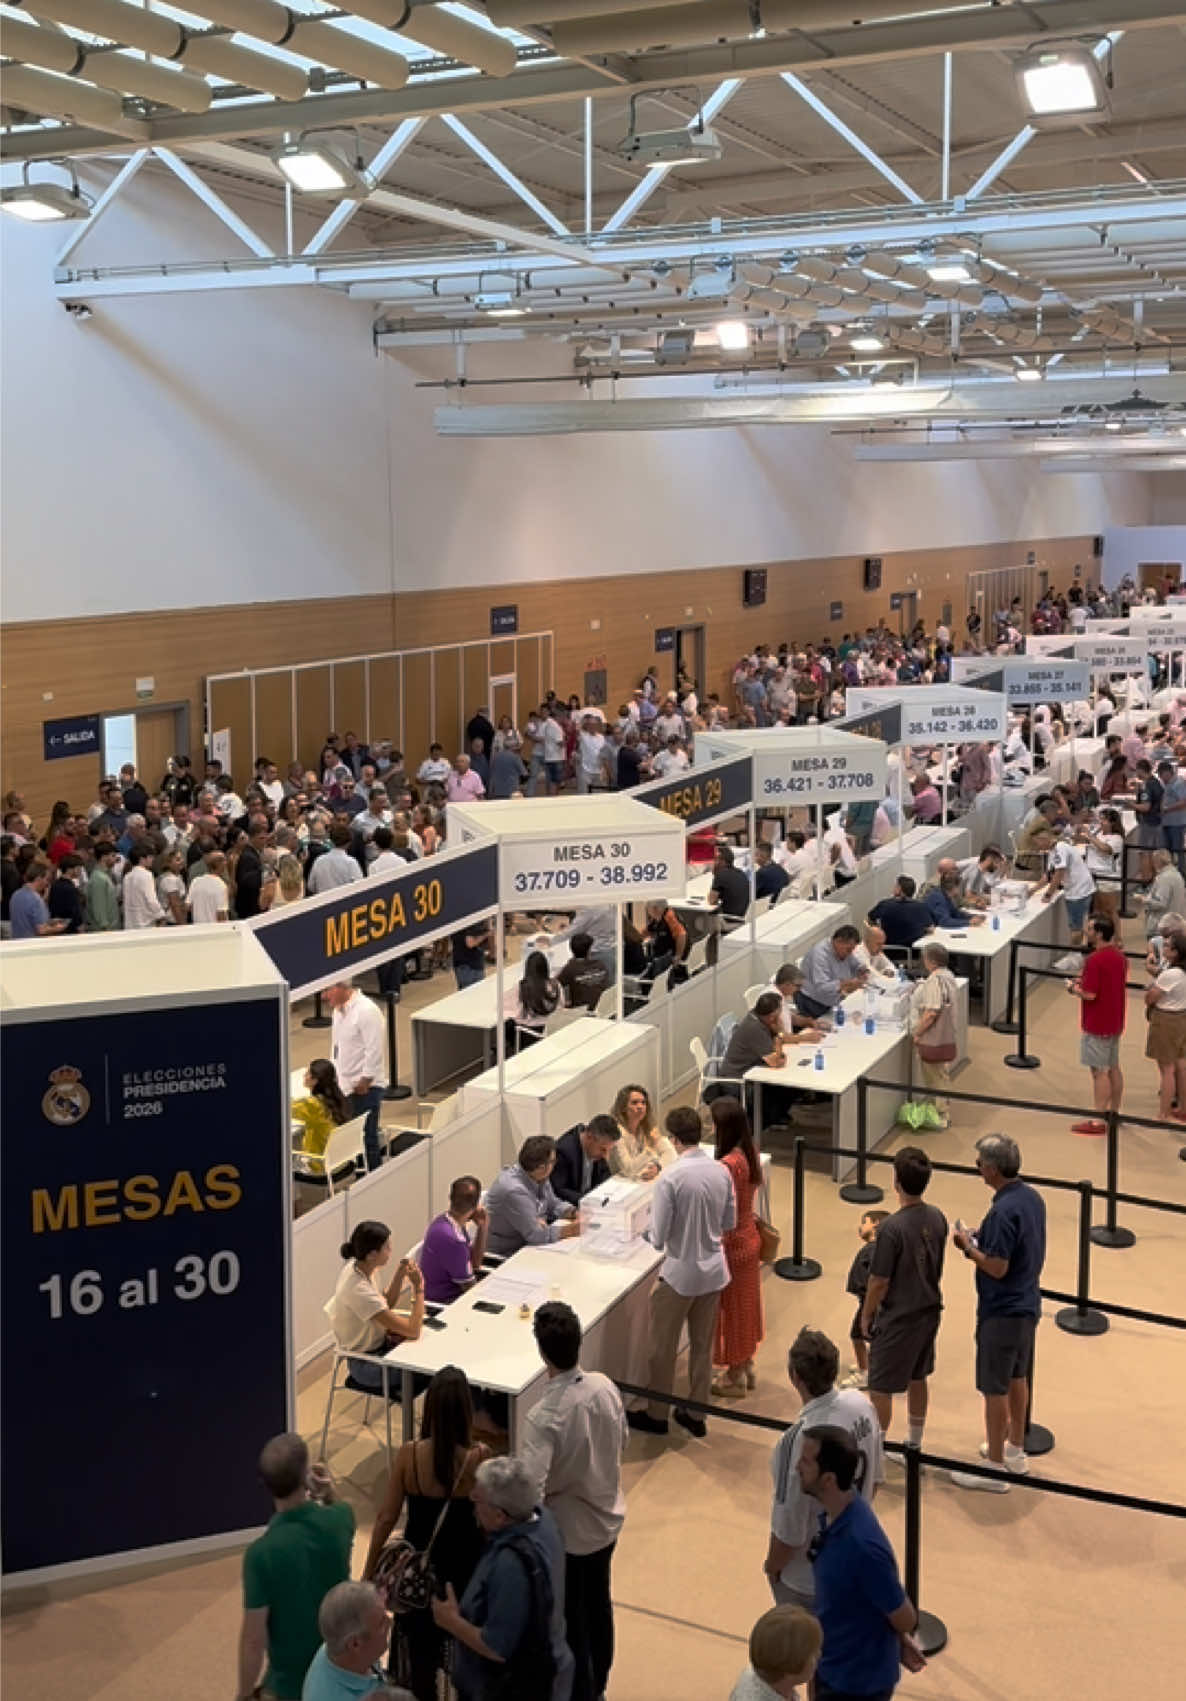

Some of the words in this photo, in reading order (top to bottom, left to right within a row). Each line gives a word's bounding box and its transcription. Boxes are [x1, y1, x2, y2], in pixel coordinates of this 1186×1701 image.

[1028, 671, 1052, 680] MESA
[931, 706, 960, 716] MESA
[908, 721, 948, 735] 35.142
[957, 718, 998, 732] 36.420
[791, 758, 828, 772] MESA
[832, 757, 847, 770] 29
[705, 778, 722, 807] 29
[764, 777, 812, 794] 36.421
[827, 773, 874, 790] 37.708
[553, 844, 605, 862] MESA
[610, 843, 631, 858] 30
[514, 869, 580, 892] 37.709
[600, 862, 668, 885] 38.992
[326, 892, 406, 957] MESA
[414, 879, 441, 921] 30
[123, 1063, 226, 1083] ELECCIONES
[123, 1076, 227, 1098] PRESIDENCIA
[124, 1101, 163, 1118] 2026
[31, 1164, 242, 1233] MESAS
[39, 1269, 104, 1319] 16
[118, 1268, 159, 1308] al
[174, 1250, 240, 1300] 30
